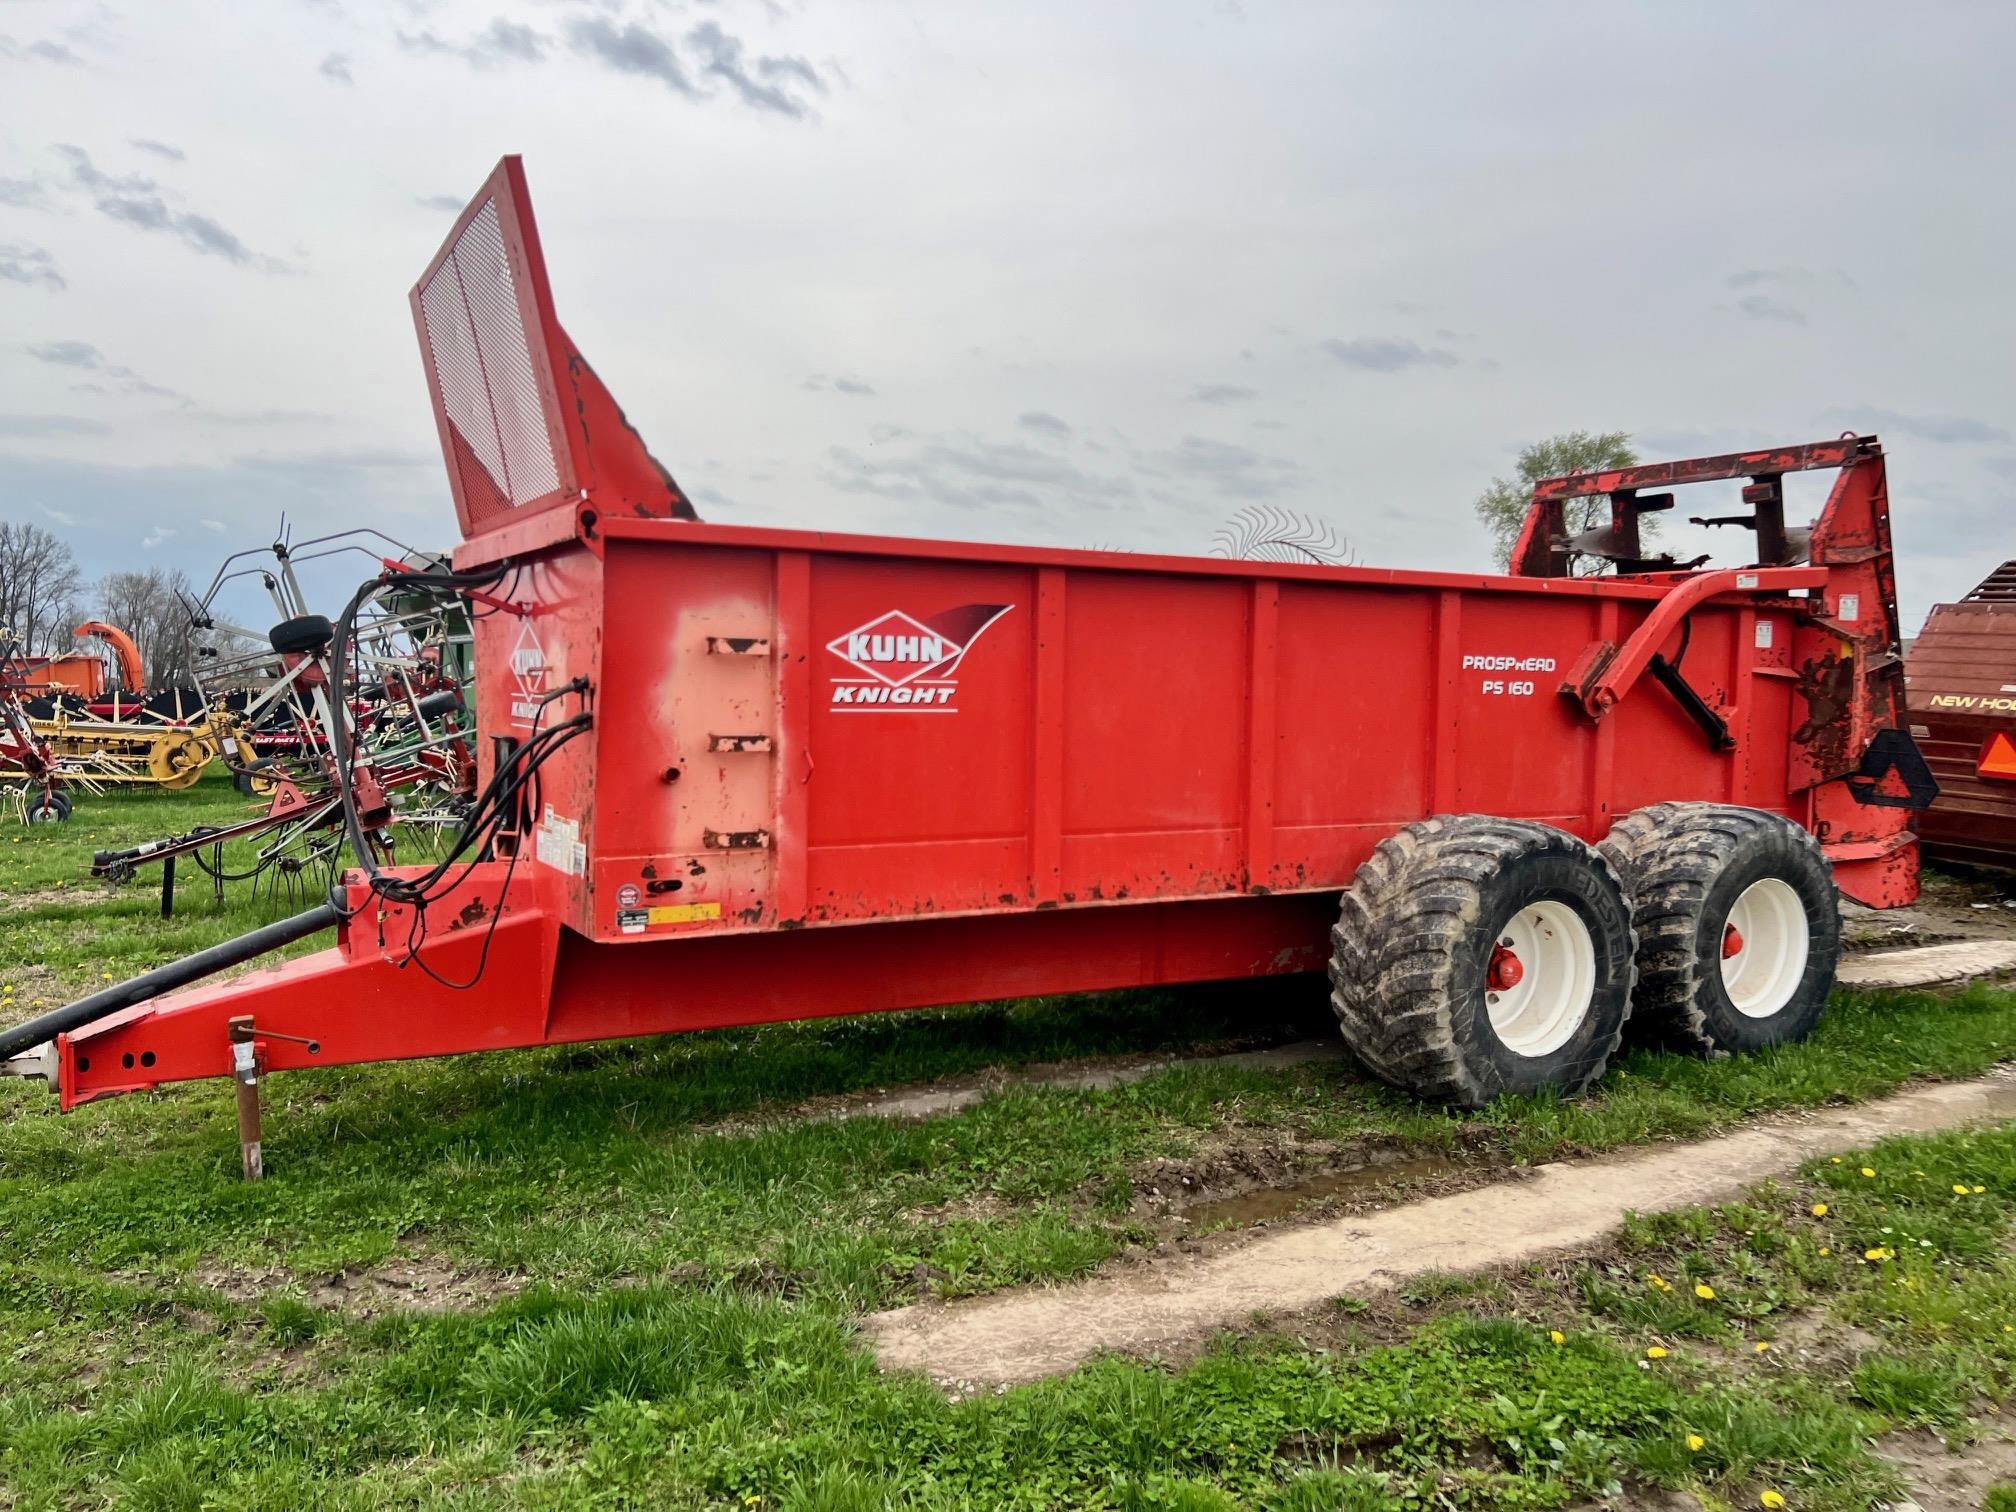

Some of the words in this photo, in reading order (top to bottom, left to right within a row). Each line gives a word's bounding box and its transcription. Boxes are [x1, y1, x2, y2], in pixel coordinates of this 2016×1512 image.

[848, 634, 943, 663] KUHN
[831, 686, 956, 704] KNIGHT
[1482, 681, 1504, 695] PS
[1508, 682, 1534, 696] 160
[1930, 695, 1979, 708] NEW
